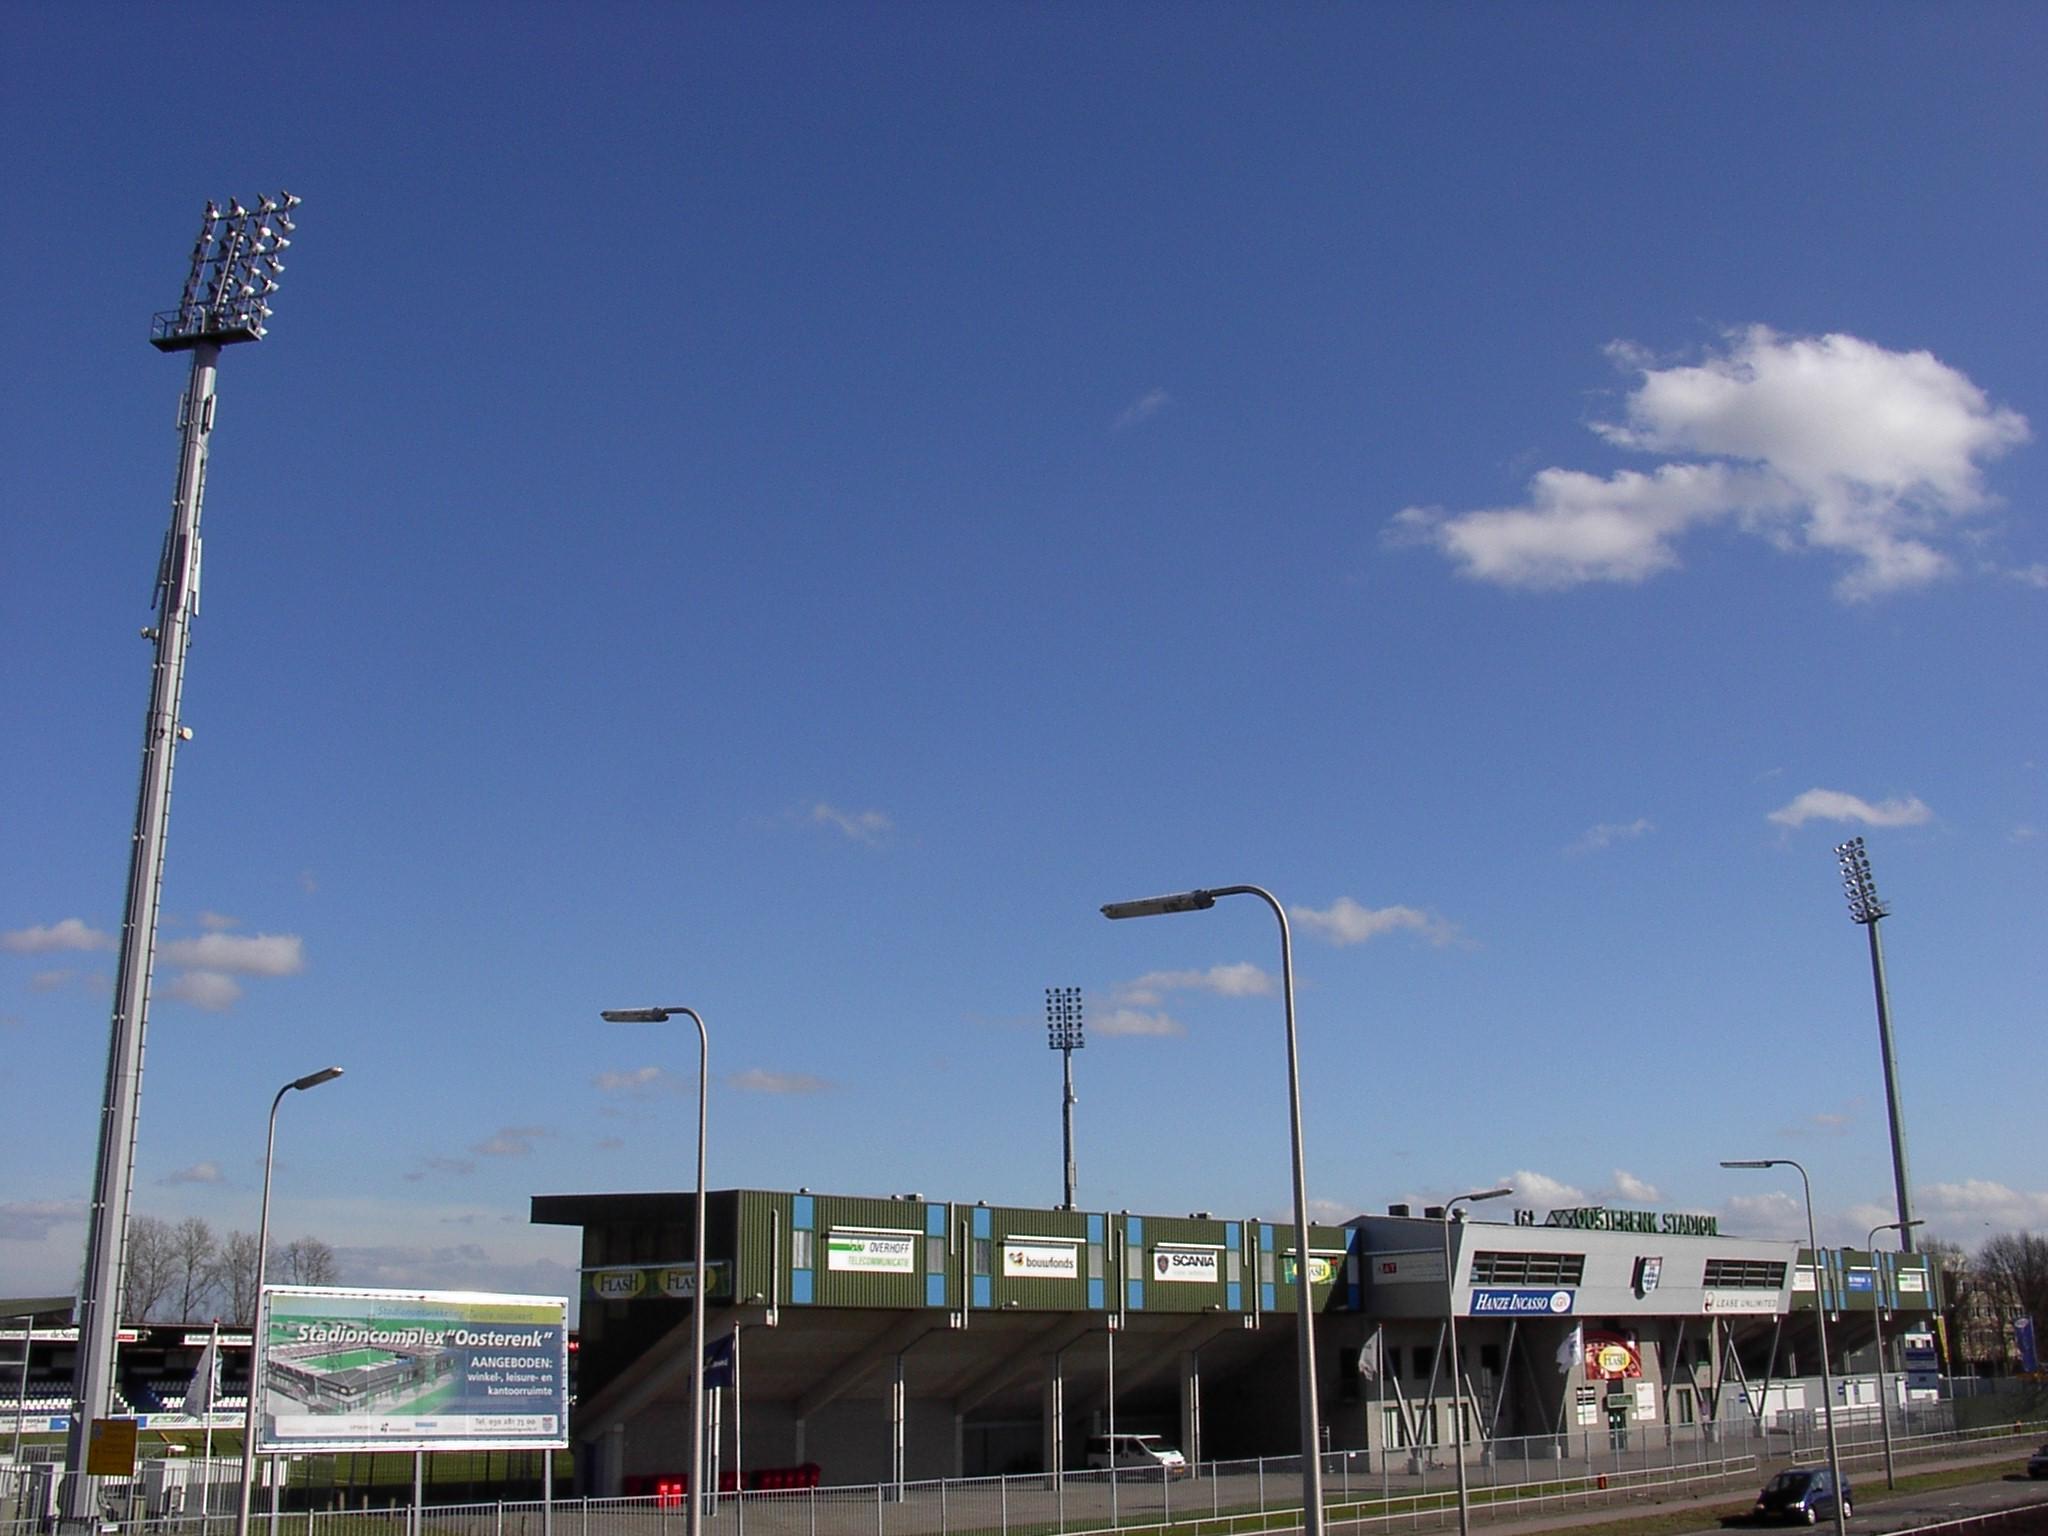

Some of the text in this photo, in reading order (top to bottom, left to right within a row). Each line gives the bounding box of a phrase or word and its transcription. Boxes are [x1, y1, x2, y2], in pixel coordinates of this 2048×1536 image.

[1575, 1208, 1717, 1235] OOSTERENK STADION
[869, 1242, 910, 1254] OVERHOFF
[1026, 1255, 1074, 1269] bouwfonds
[1172, 1255, 1215, 1267] SCANIA
[600, 1273, 639, 1292] FLASH
[1475, 1293, 1510, 1310] HANZE
[1509, 1293, 1548, 1310] INCASSO
[1716, 1299, 1738, 1308] LEASE
[297, 1325, 446, 1348] Stadioncomplex
[471, 1357, 553, 1369] AANGEBODEN:
[506, 1372, 539, 1382] leisure-
[541, 1374, 553, 1382] en
[488, 1386, 553, 1396] kantoorruimte
